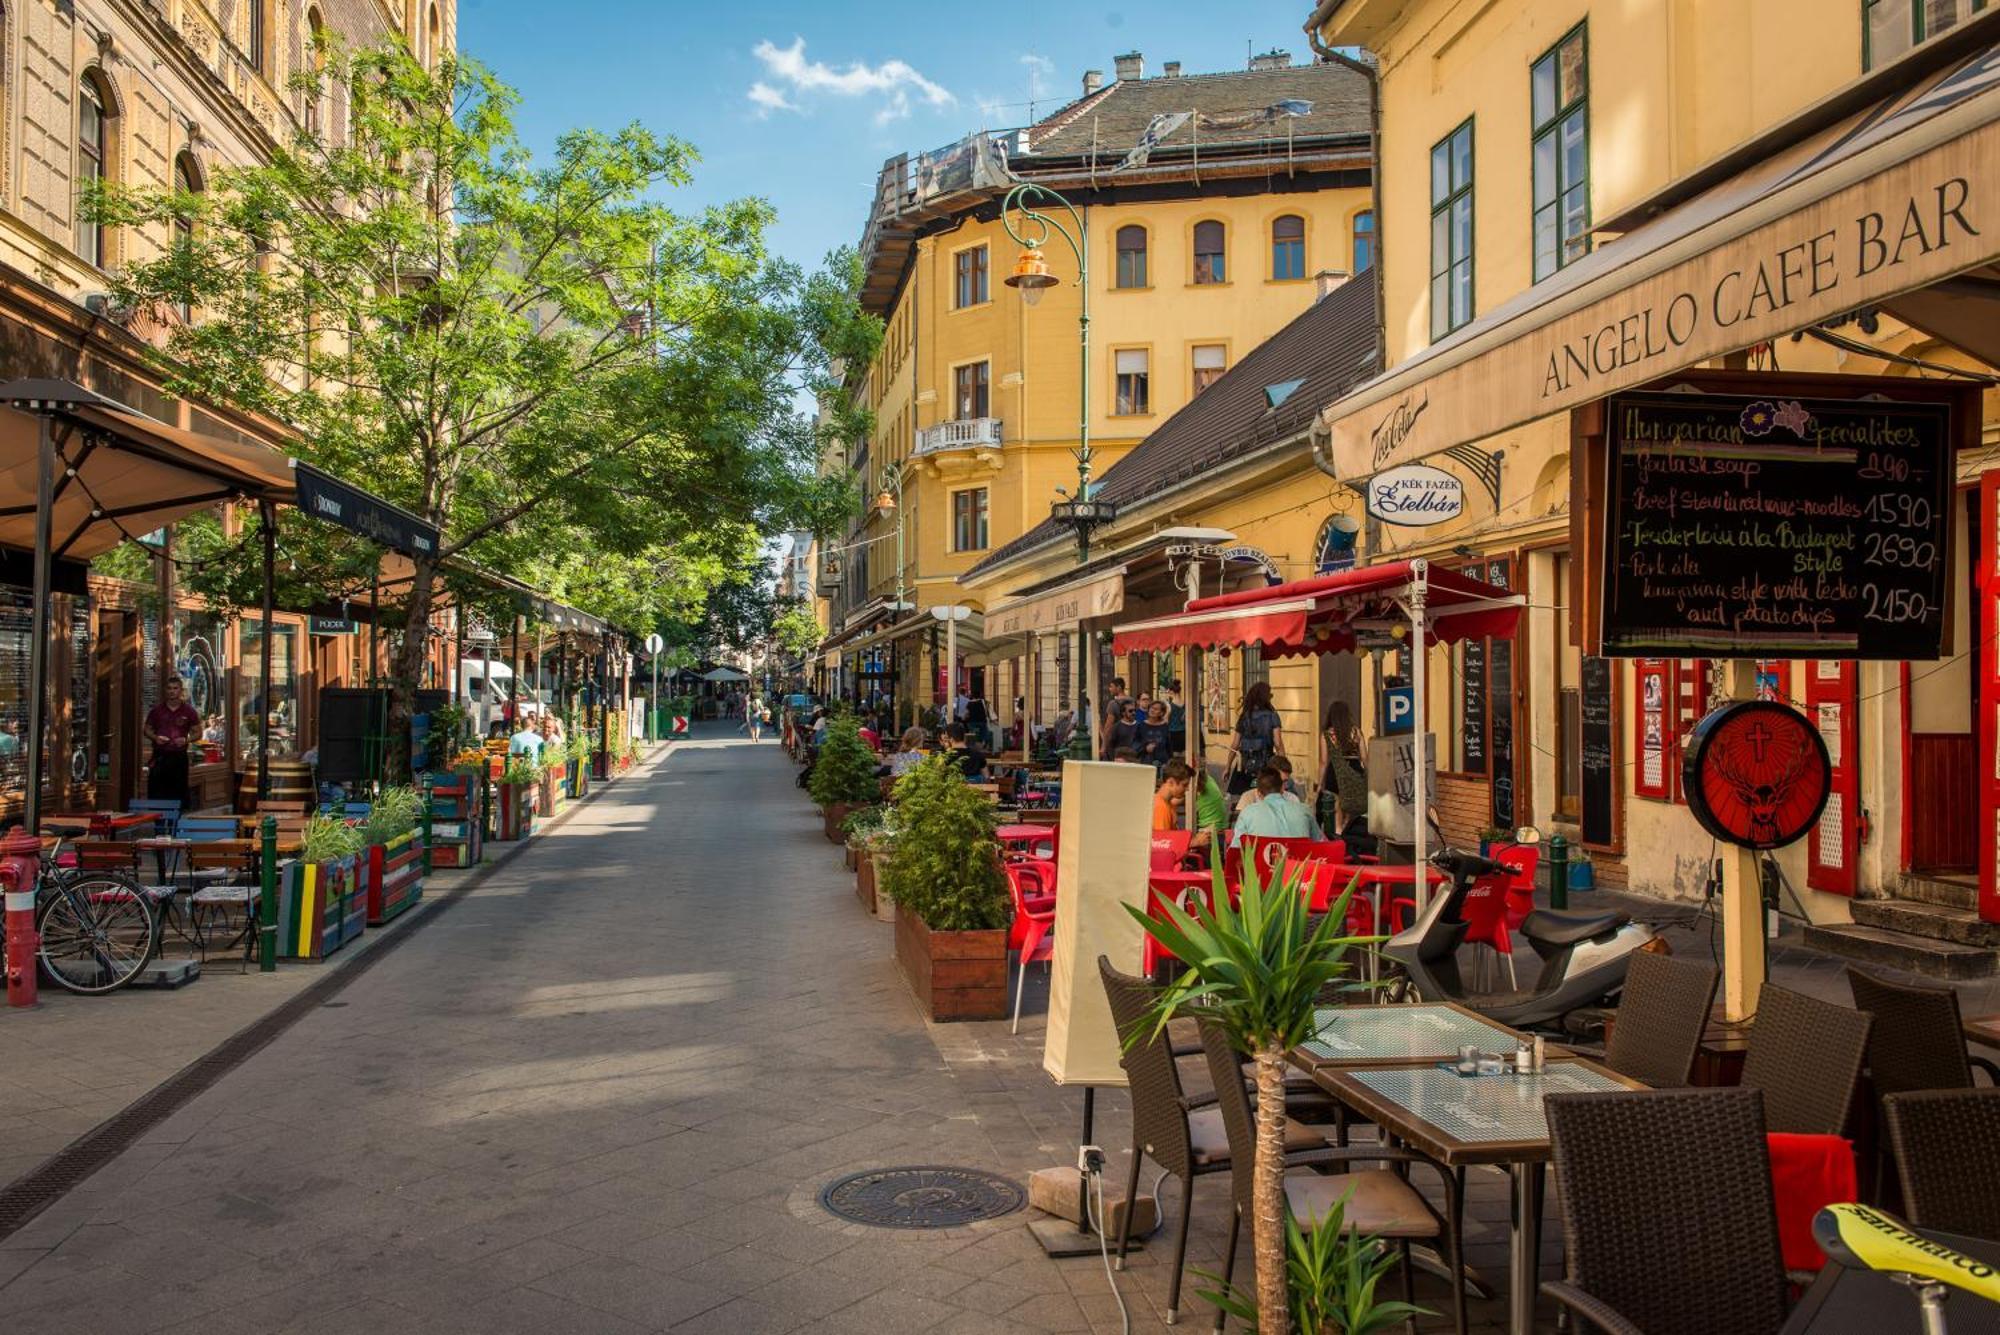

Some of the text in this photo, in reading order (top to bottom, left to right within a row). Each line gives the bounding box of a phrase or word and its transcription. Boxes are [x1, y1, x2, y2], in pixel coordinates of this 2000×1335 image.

[1542, 177, 1981, 398] ANGELO CAFE BAR
[1625, 408, 1744, 447] Hungarian
[1401, 479, 1459, 490] KÉK FAZÉK
[1713, 459, 1761, 488] soup
[1373, 480, 1460, 513] Ételbár
[1633, 489, 1677, 517] Beef
[1775, 521, 1856, 554] Budapest
[1687, 604, 1728, 625] and
[1390, 695, 1411, 722] P
[1849, 1205, 1994, 1279] san marco
